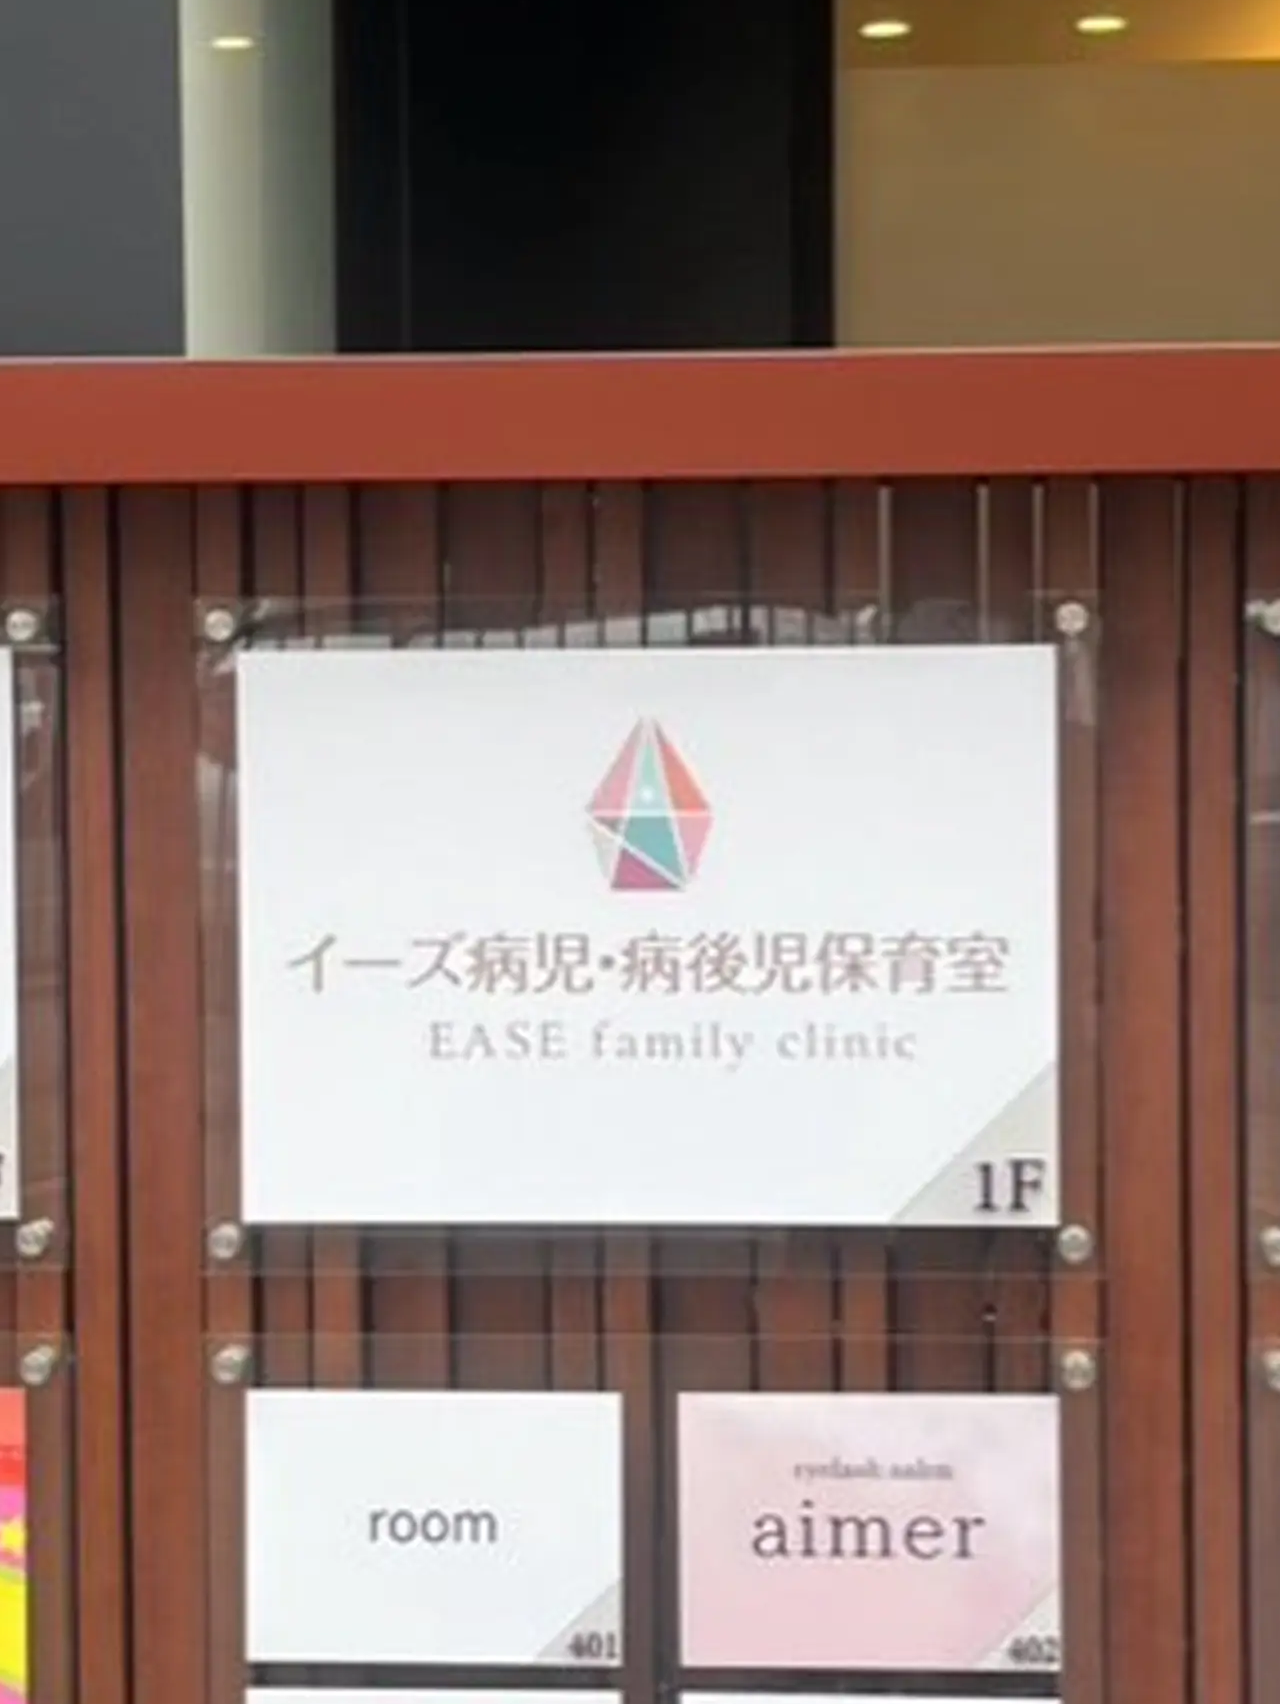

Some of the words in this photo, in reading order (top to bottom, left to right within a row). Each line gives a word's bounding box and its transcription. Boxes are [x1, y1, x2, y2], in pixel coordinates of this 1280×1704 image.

[288, 930, 1010, 996] イーズ病児・病後児保育室
[429, 1020, 566, 1061] EASE
[592, 1020, 754, 1071] family
[776, 1021, 917, 1061] clinic
[974, 1159, 1045, 1213] 1F
[368, 1508, 498, 1545] room
[752, 1499, 986, 1561] aimer
[567, 1633, 618, 1660] 401
